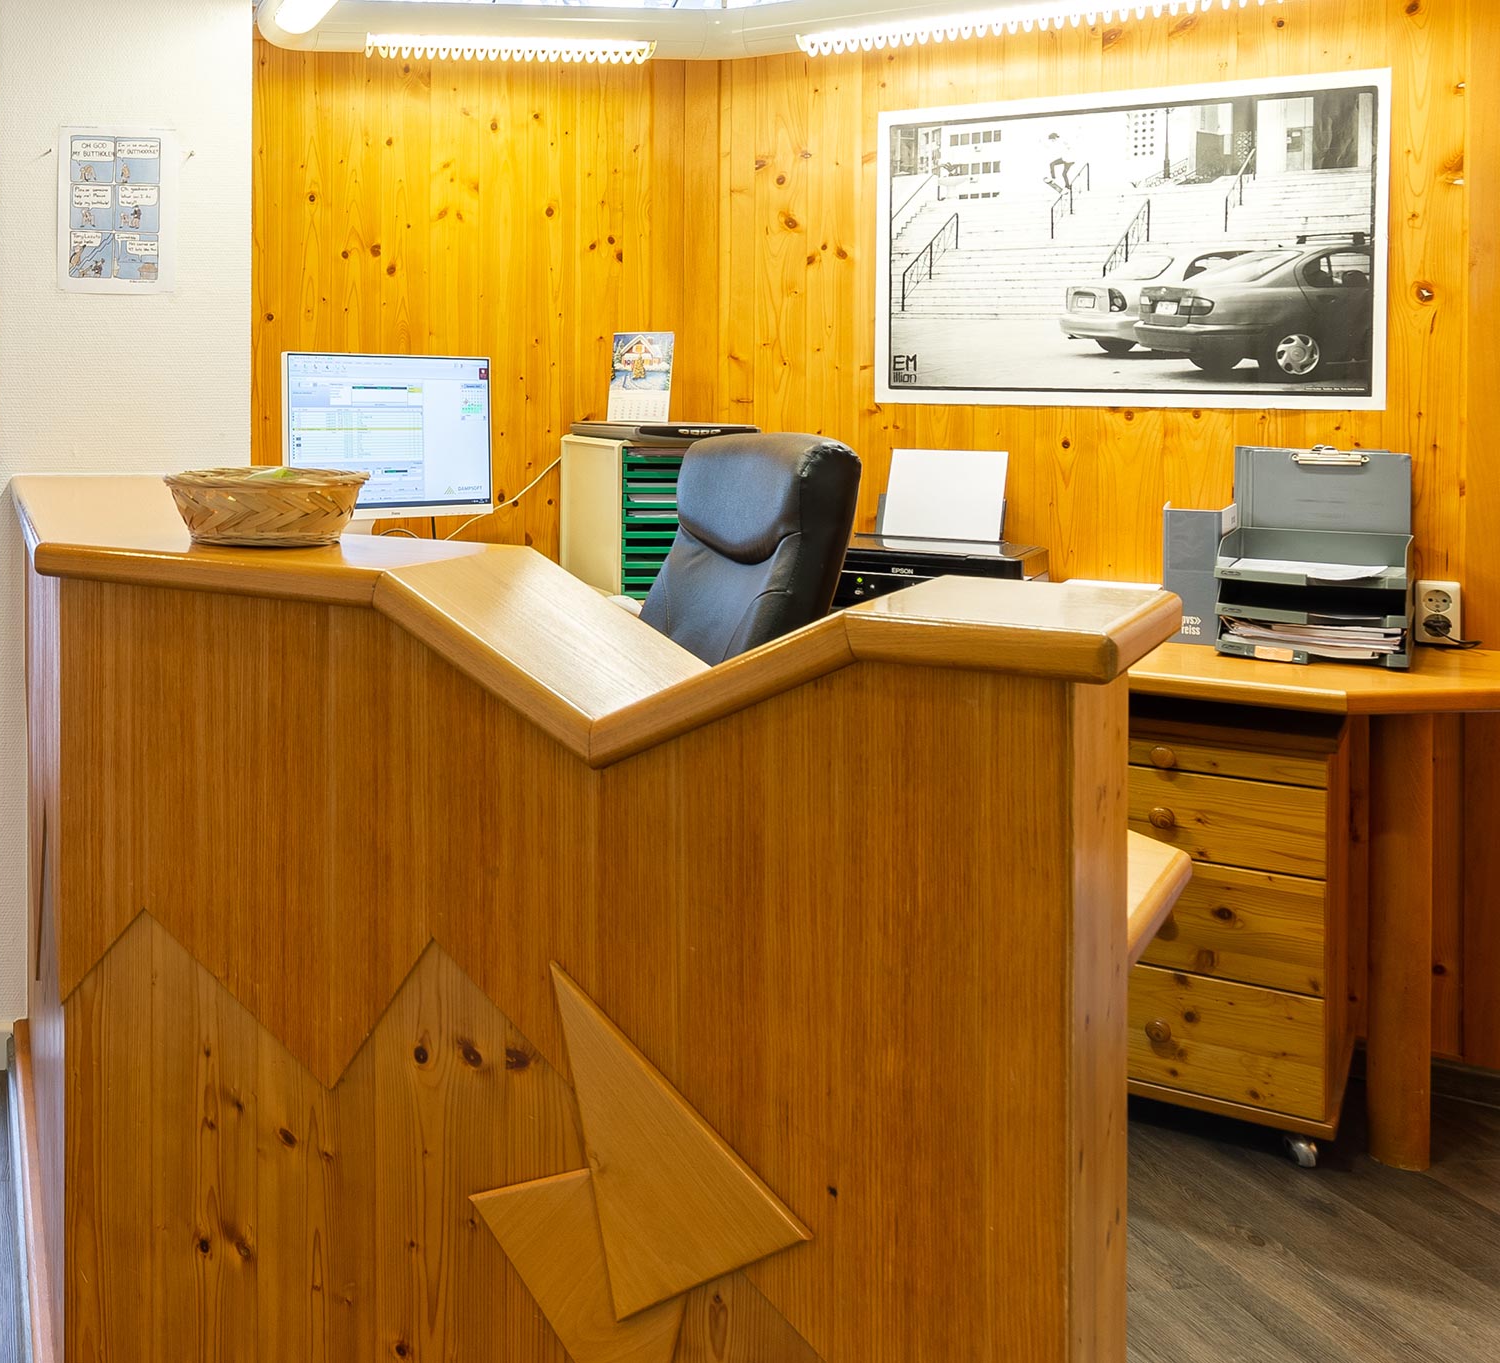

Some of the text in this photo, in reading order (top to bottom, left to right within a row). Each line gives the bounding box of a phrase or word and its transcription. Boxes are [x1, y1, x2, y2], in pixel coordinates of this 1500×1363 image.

[893, 354, 917, 372] EM
[893, 372, 917, 383] illion
[891, 567, 914, 575] EPSON
[1181, 625, 1201, 635] reiss
